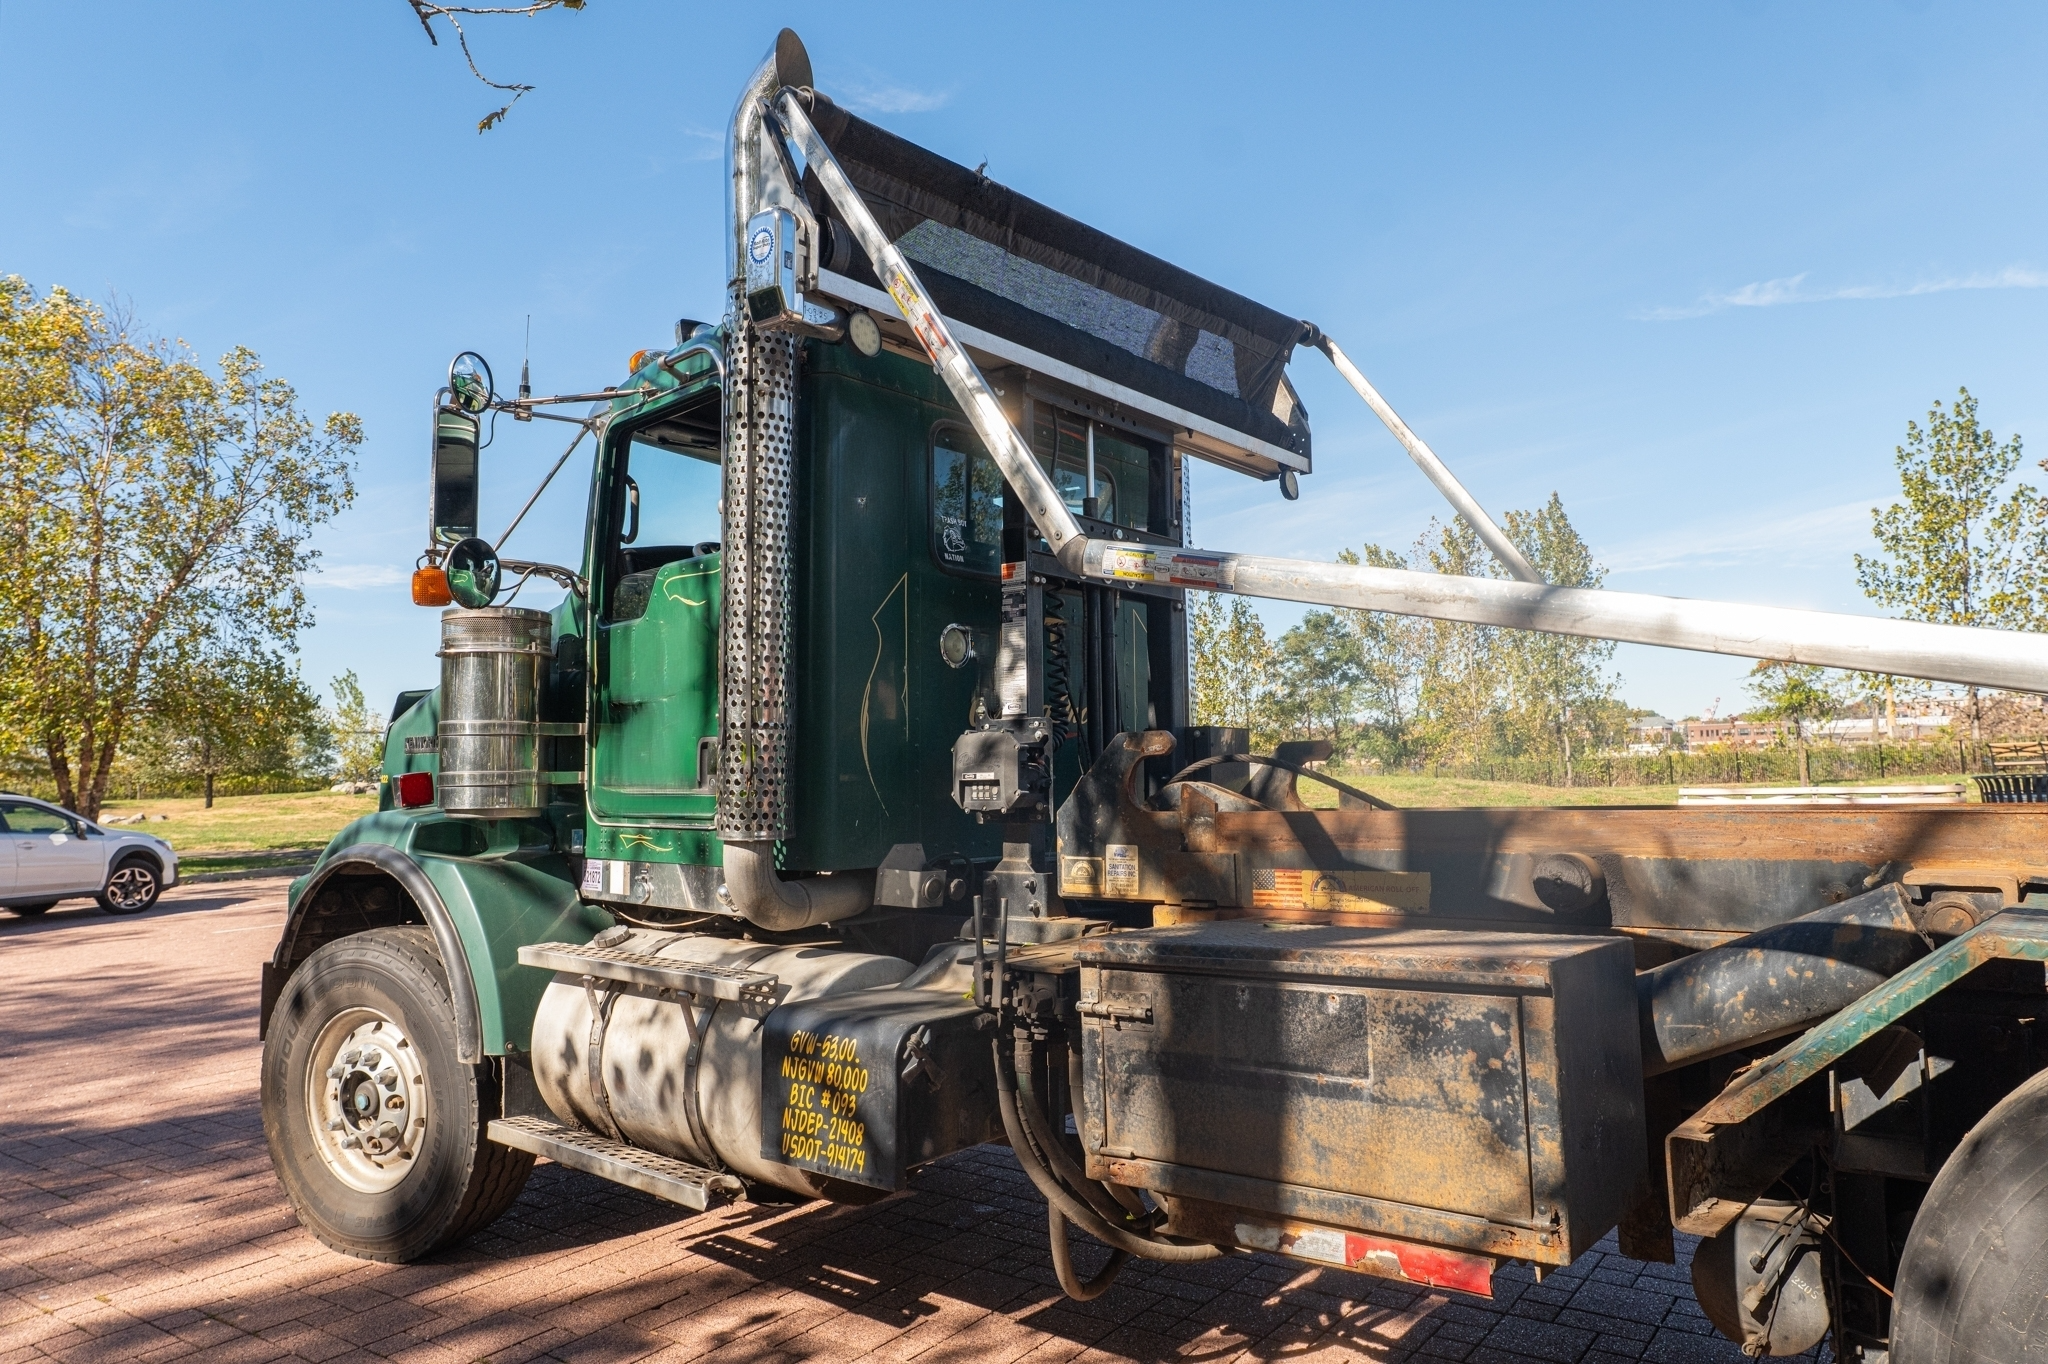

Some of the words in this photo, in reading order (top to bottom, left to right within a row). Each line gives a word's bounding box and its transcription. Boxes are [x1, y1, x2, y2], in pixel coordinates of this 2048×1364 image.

[944, 553, 965, 562] NATION
[1348, 885, 1385, 893] AMERICAN
[781, 1055, 825, 1084] NJGVW
[826, 1063, 868, 1092] 80,000
[789, 1083, 815, 1109] BIC
[782, 1107, 865, 1146] NJDEP-21408
[782, 1133, 866, 1173] USDOT-914174
